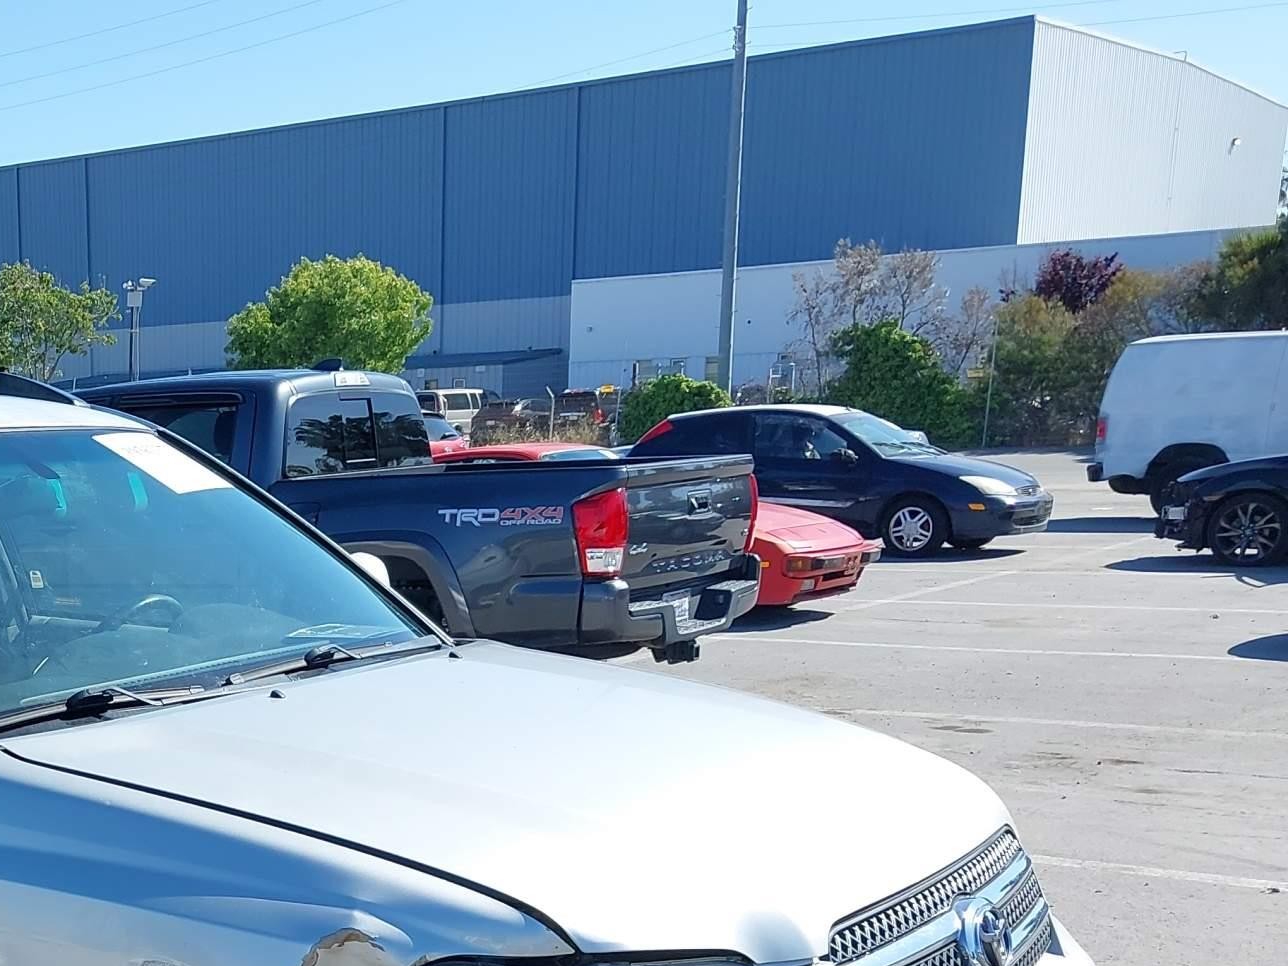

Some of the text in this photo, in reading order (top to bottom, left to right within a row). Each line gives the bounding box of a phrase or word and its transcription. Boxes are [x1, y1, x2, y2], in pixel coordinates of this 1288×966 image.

[437, 508, 500, 527] TRD
[526, 518, 562, 526] ROAD
[651, 550, 726, 573] TACOMA
